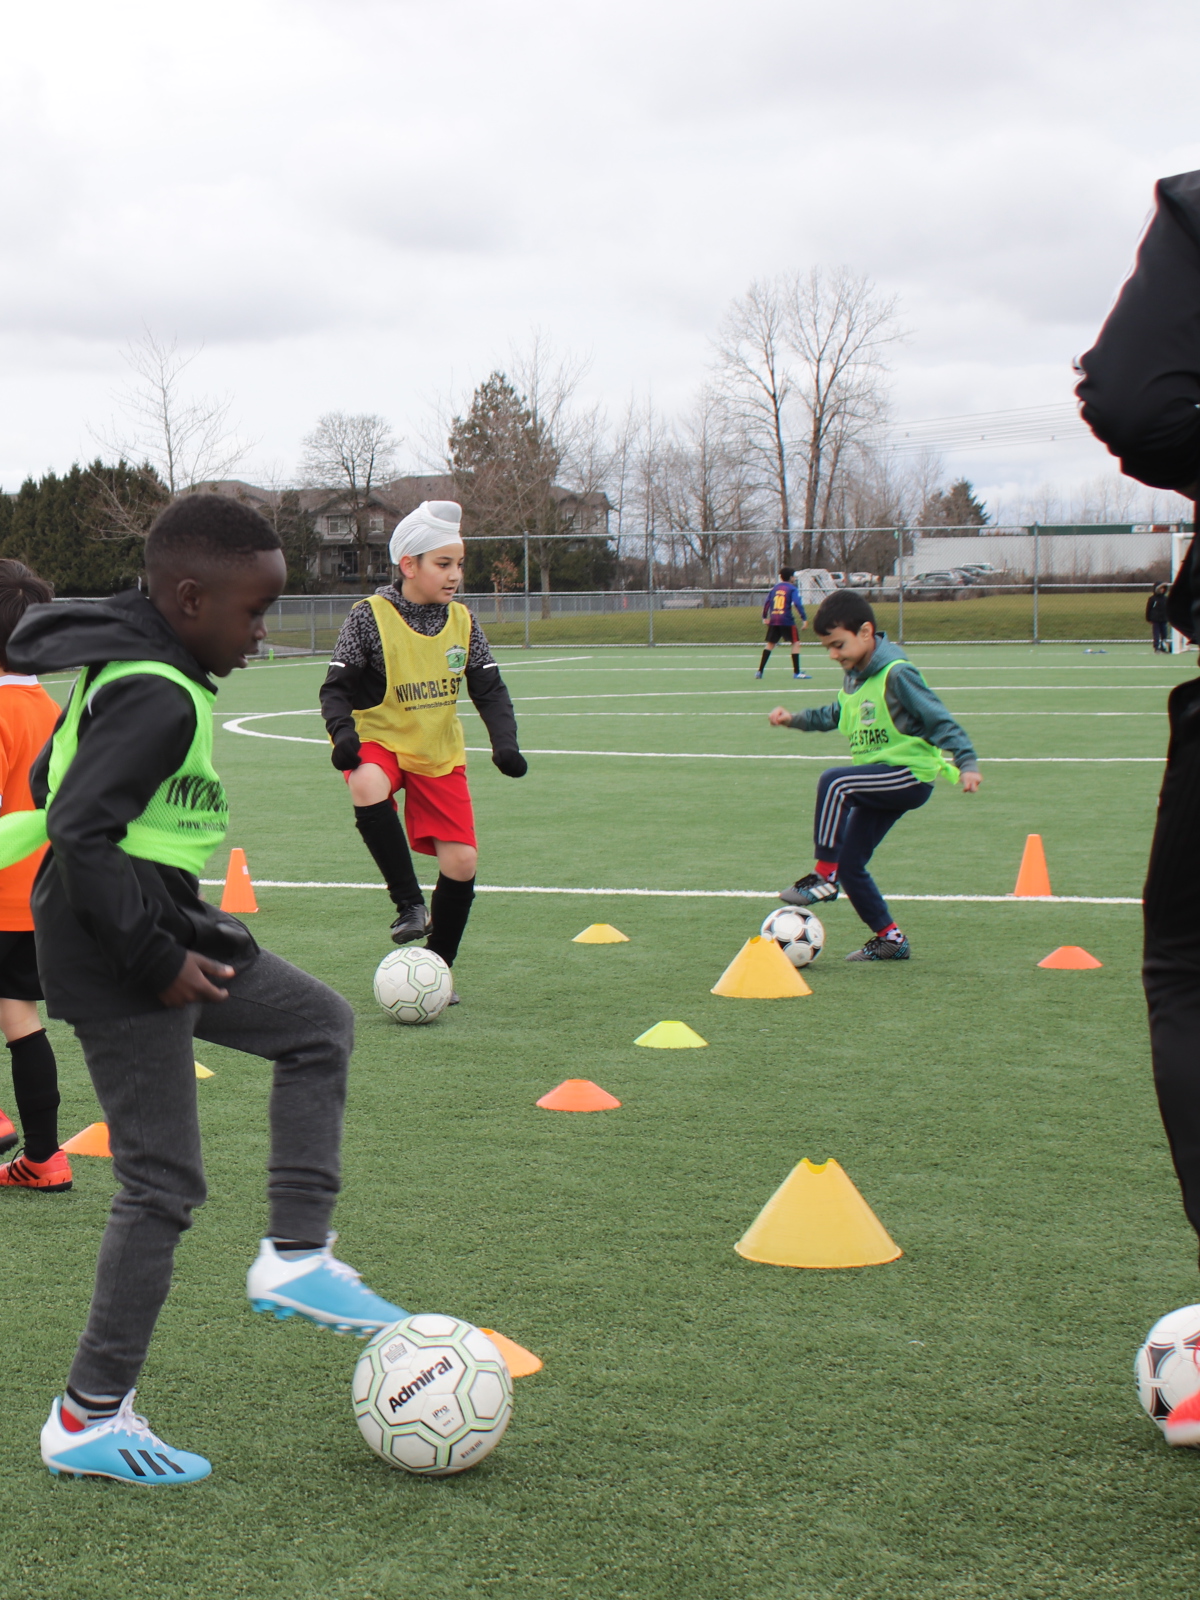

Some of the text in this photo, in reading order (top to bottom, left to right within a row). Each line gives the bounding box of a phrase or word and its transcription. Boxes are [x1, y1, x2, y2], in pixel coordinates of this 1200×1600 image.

[773, 594, 786, 610] 10
[859, 728, 889, 746] STARS
[388, 1355, 454, 1414] Admiral
